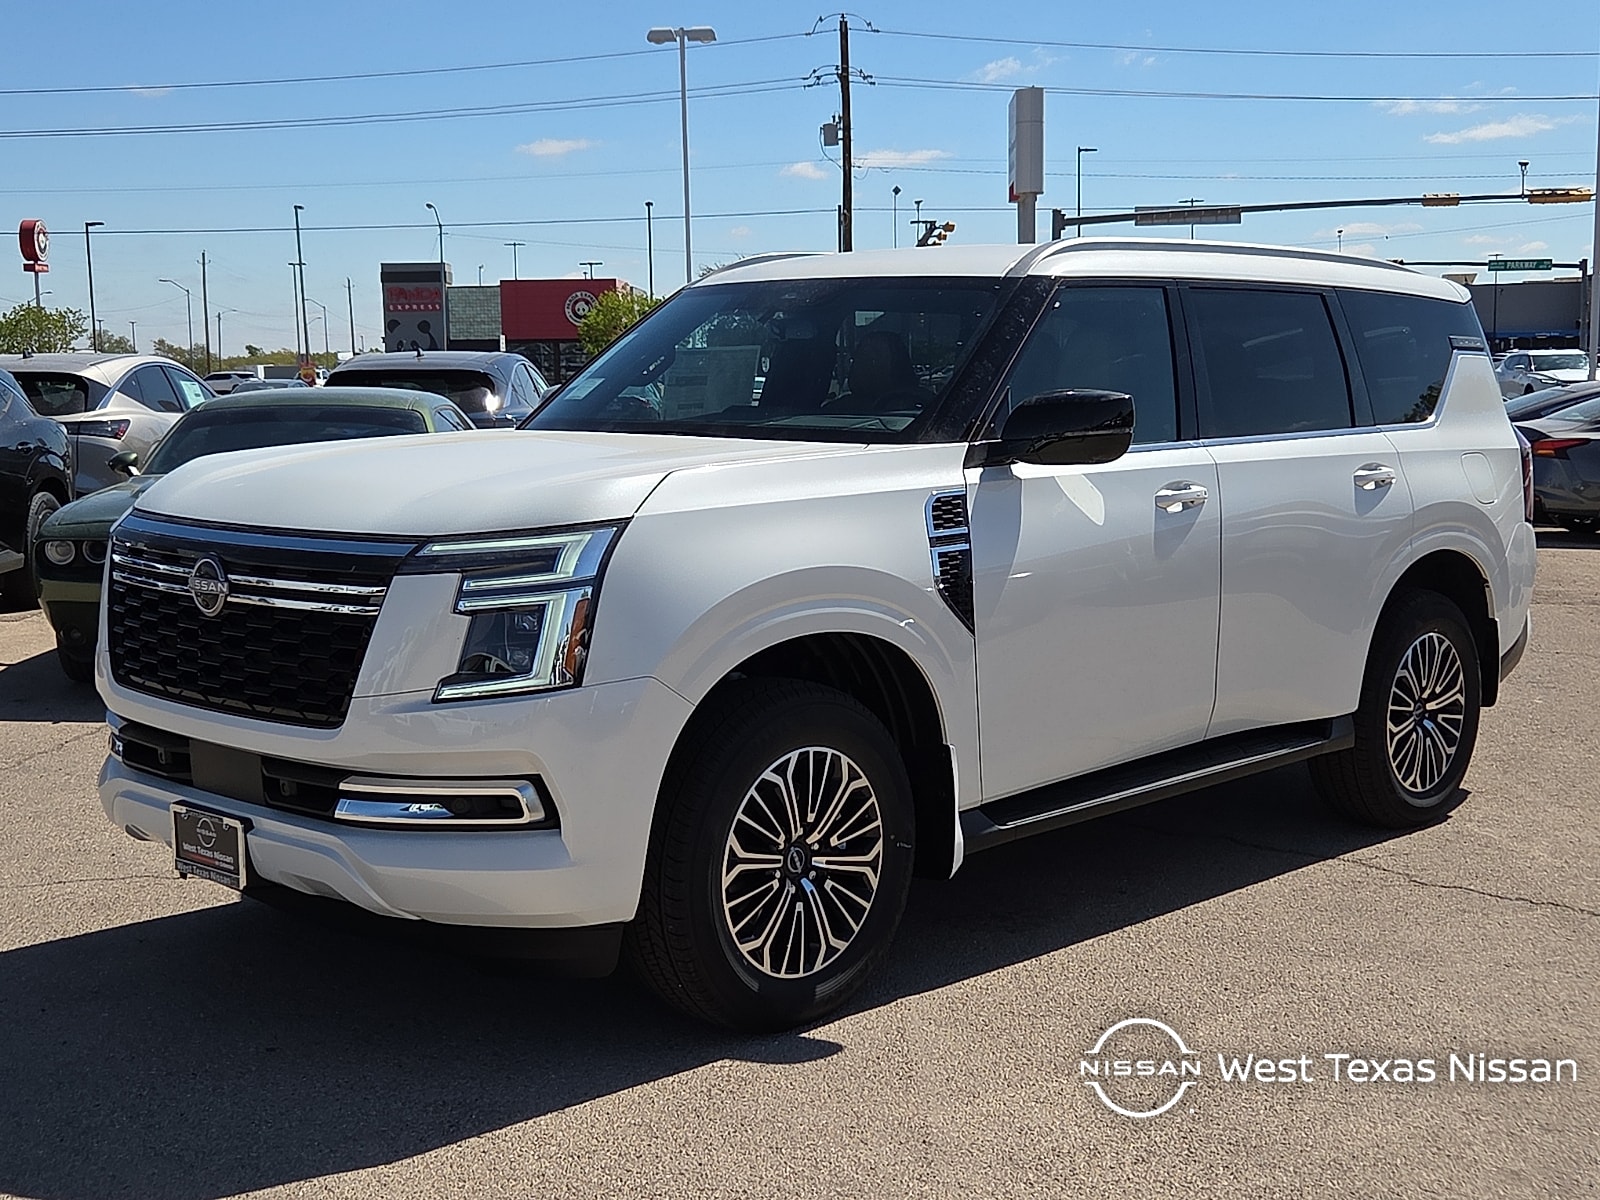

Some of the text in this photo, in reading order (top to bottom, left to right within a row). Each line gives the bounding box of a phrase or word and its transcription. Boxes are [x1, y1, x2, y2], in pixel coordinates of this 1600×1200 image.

[1506, 261, 1537, 269] PARKWAY
[387, 286, 441, 303] PANDA
[190, 579, 228, 593] SSAN
[182, 842, 234, 864] West Texas Nissan
[177, 862, 192, 874] West
[193, 866, 209, 879] Texas
[210, 871, 231, 885] Nissan
